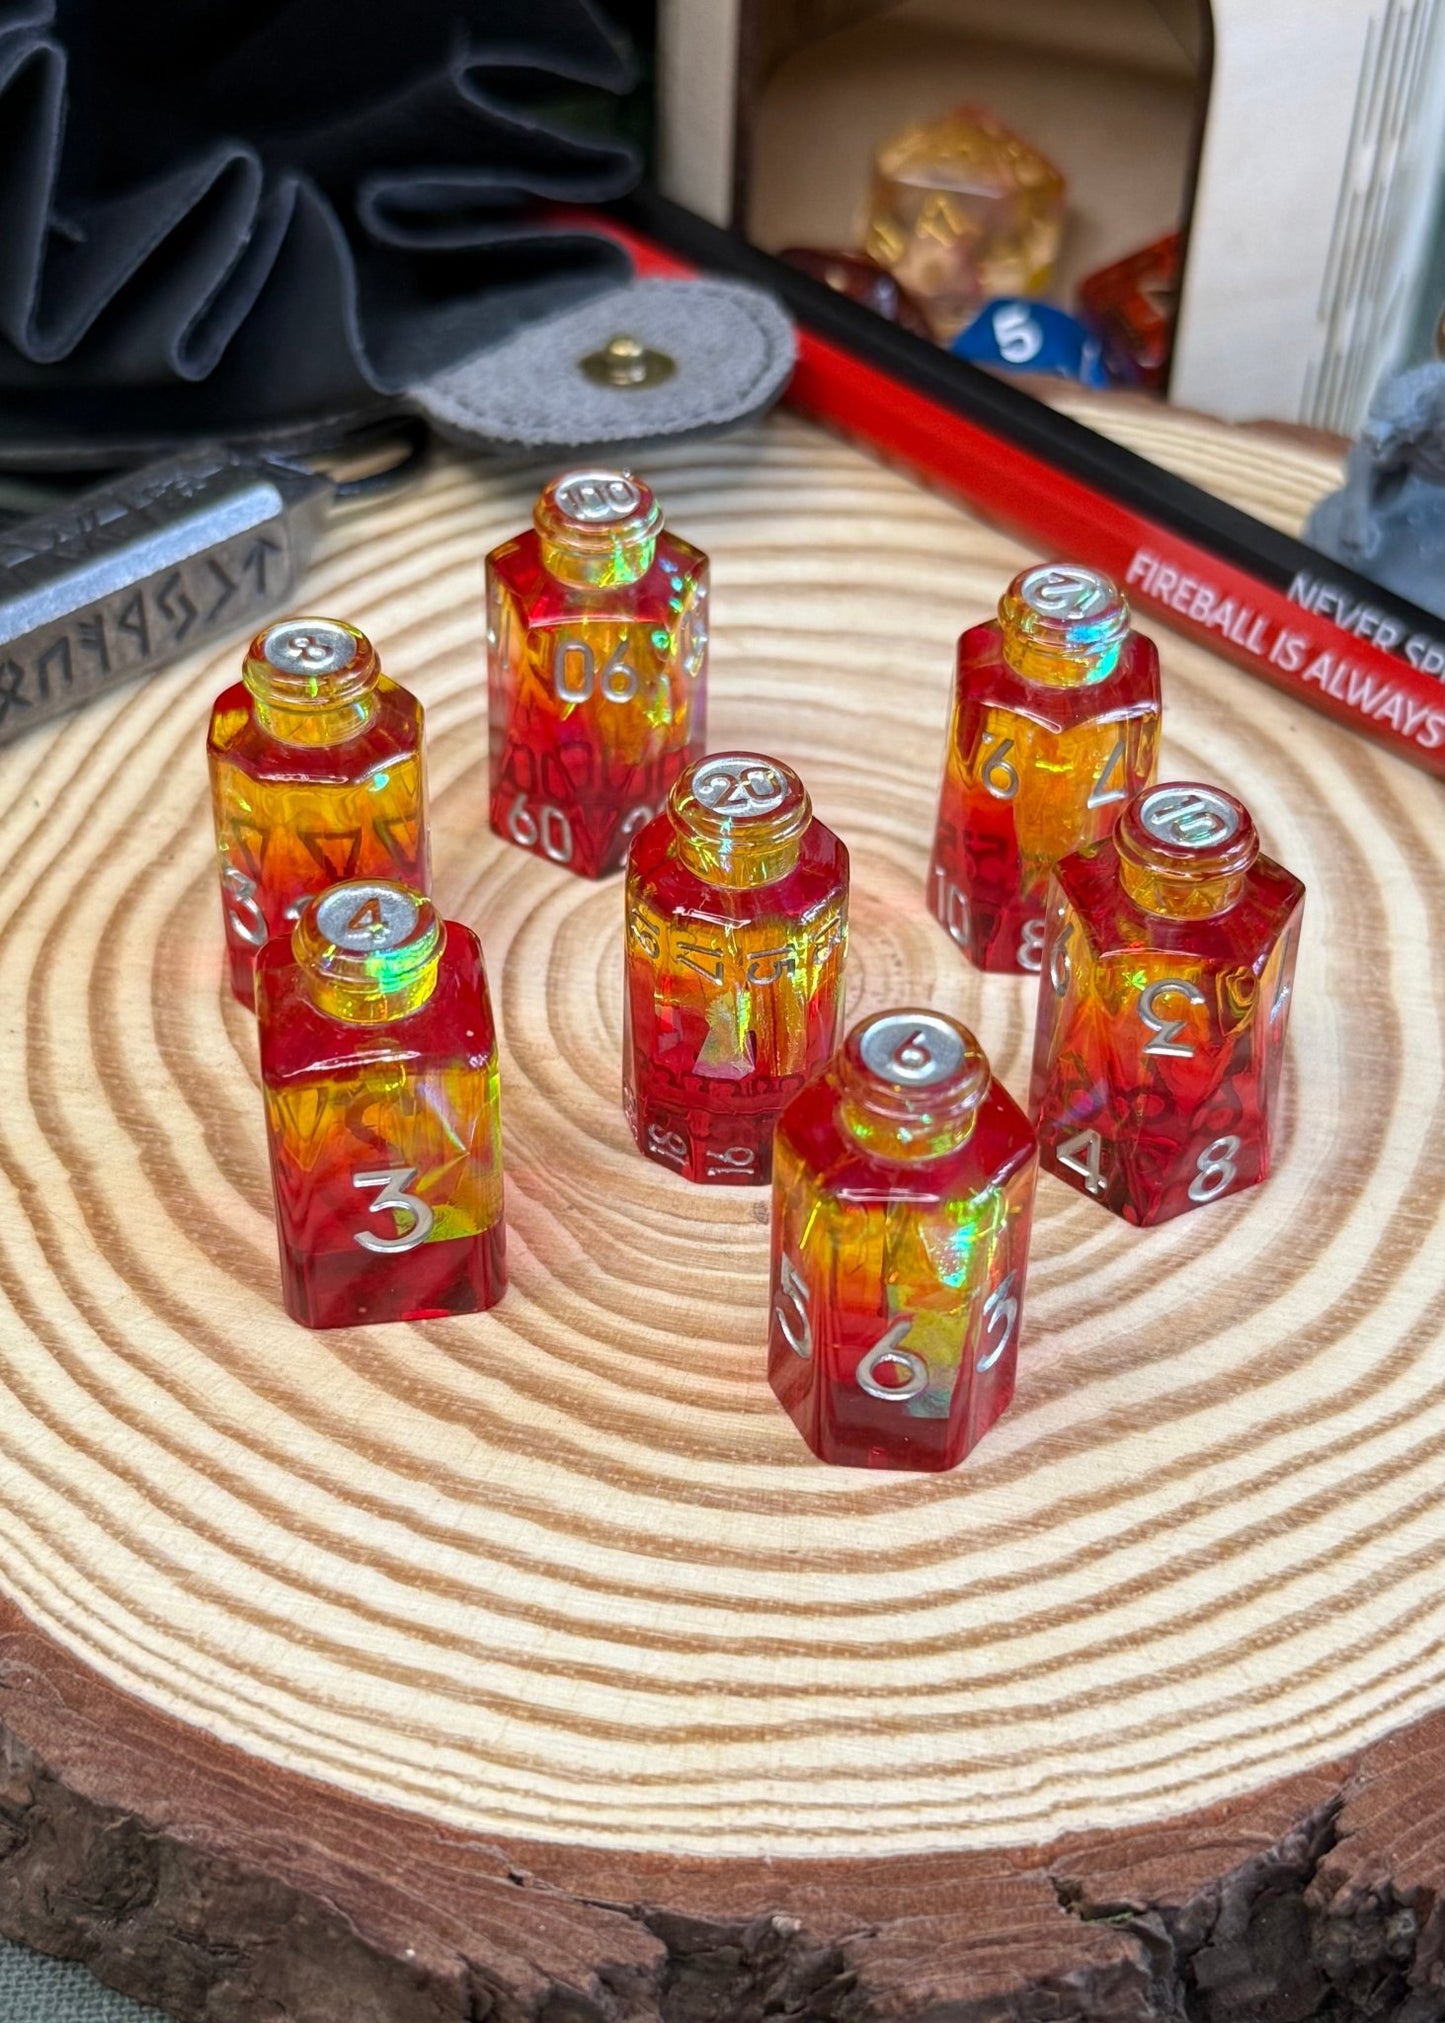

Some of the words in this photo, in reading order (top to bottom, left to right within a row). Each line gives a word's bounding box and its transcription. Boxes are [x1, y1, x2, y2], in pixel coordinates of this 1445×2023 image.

[993, 303, 1043, 363] 5
[560, 480, 637, 520] 100
[1286, 571, 1403, 653] NEVER
[288, 635, 334, 672] 8
[1126, 549, 1268, 655] FIREBALL
[1269, 628, 1306, 673] IS
[1302, 650, 1445, 748] ALWAYS
[698, 766, 785, 813] 20
[508, 792, 573, 863] 60
[226, 866, 269, 946] 3
[346, 897, 390, 942] 4
[934, 865, 971, 946] 10
[895, 1030, 933, 1068] 6
[1056, 1128, 1108, 1195] 4
[1187, 1134, 1242, 1203] 8
[353, 1165, 436, 1254] 3
[775, 1252, 812, 1359] 5
[855, 1318, 930, 1401] 6
